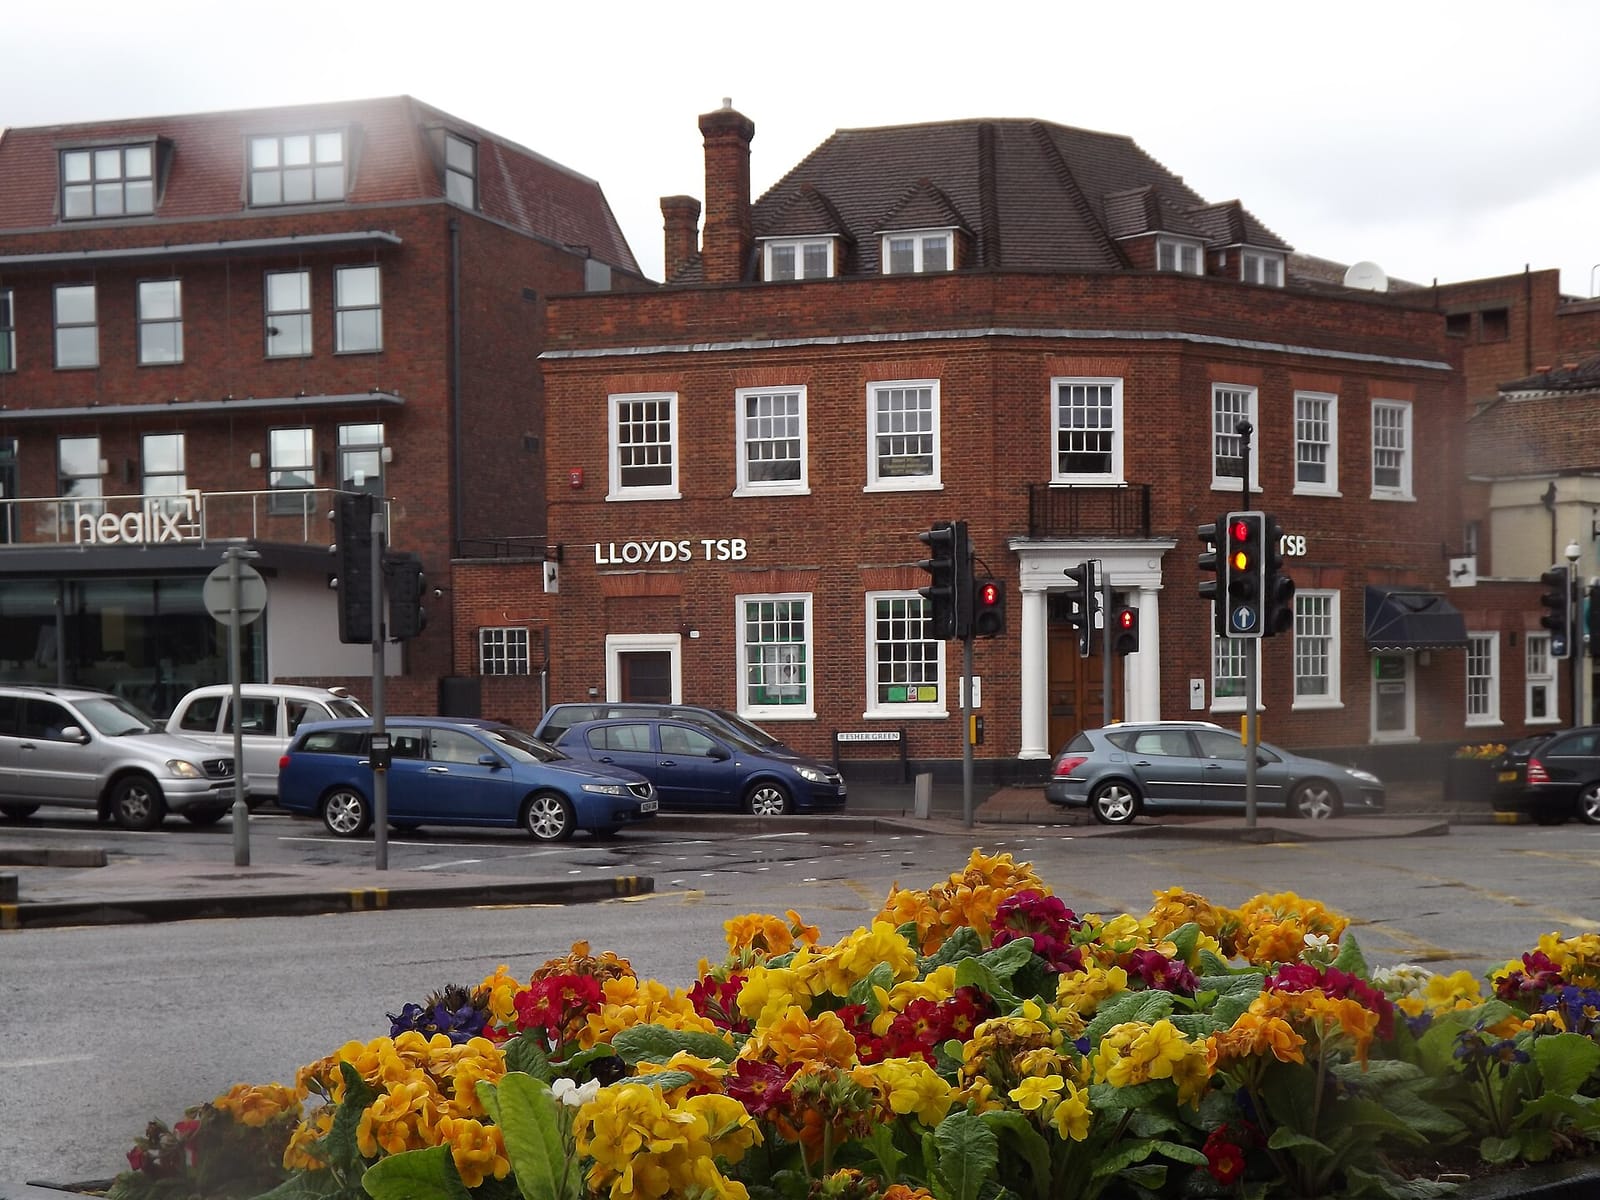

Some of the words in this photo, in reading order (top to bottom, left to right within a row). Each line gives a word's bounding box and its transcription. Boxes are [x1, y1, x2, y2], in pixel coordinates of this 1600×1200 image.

[74, 499, 182, 544] healix
[595, 541, 692, 564] LLOYDS
[701, 538, 747, 561] TSB
